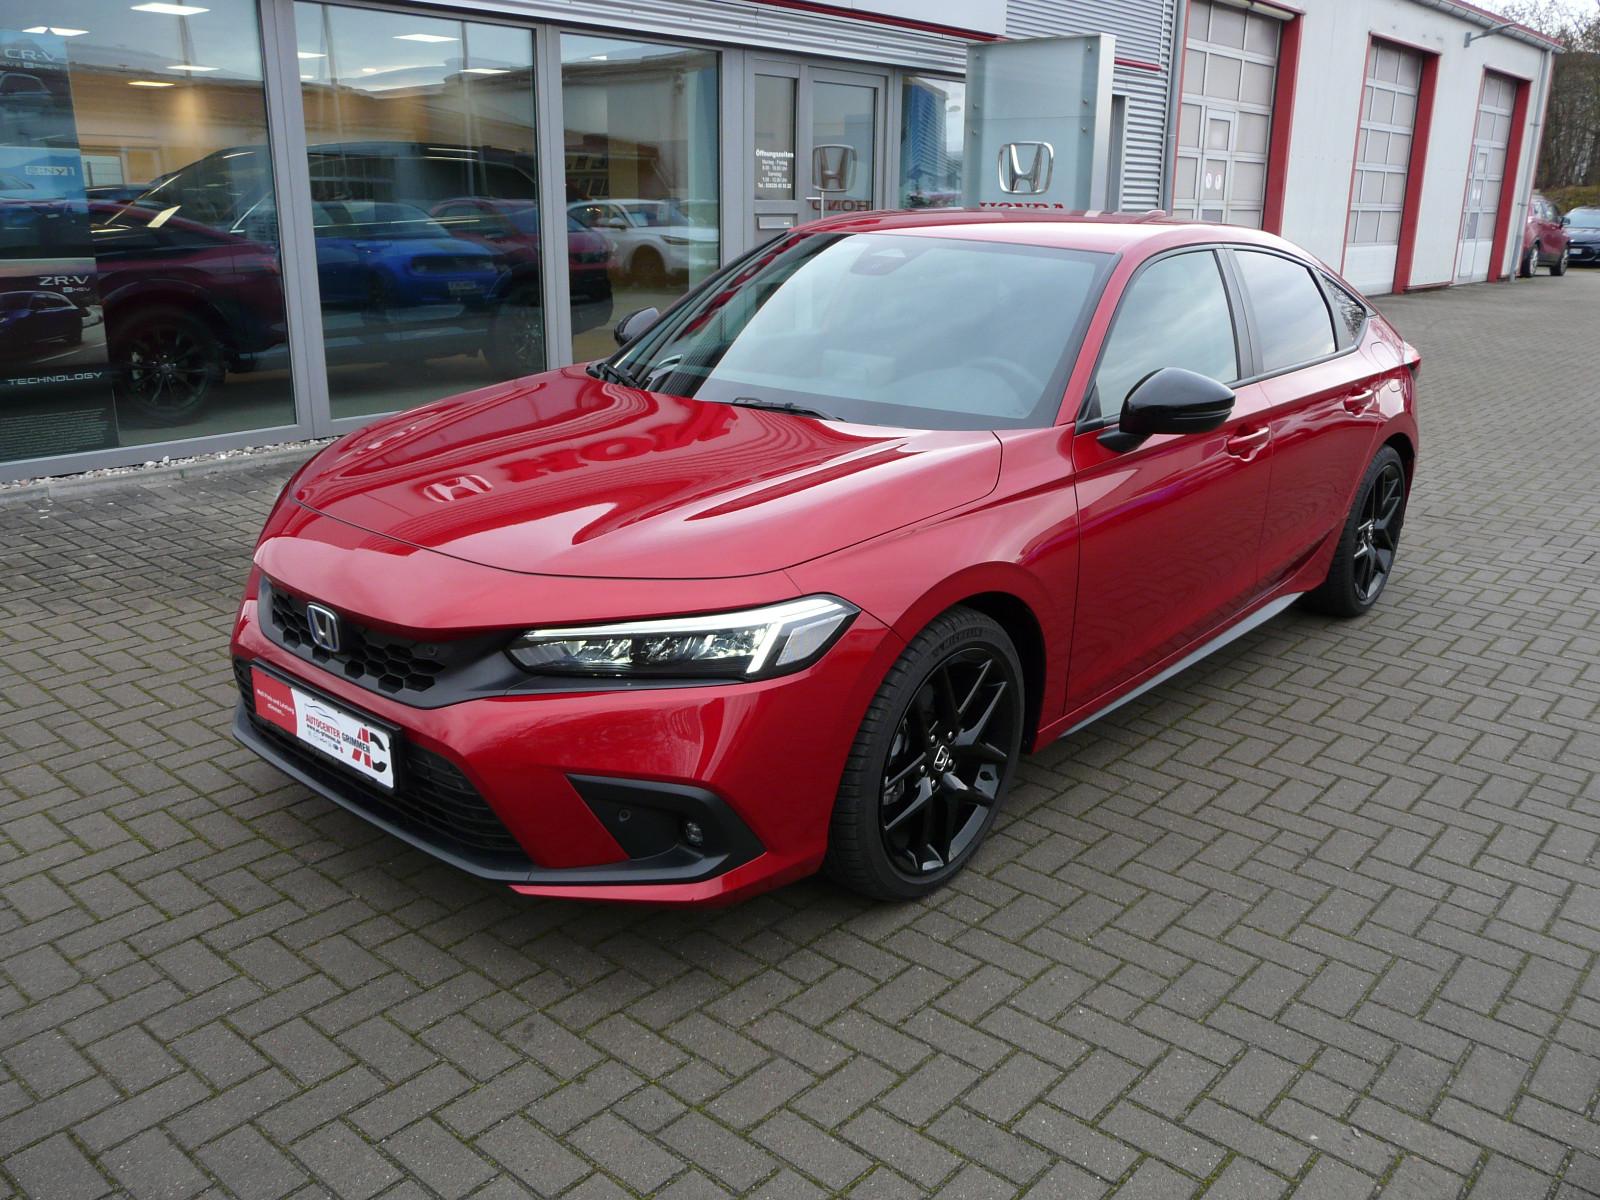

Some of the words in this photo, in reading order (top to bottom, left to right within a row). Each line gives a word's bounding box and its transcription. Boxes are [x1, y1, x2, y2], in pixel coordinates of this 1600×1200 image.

[39, 275, 89, 286] ZR-V
[7, 371, 103, 386] TECHNOLOGY
[305, 714, 341, 740] AUTOCENTER
[341, 732, 371, 754] GRIMMEN
